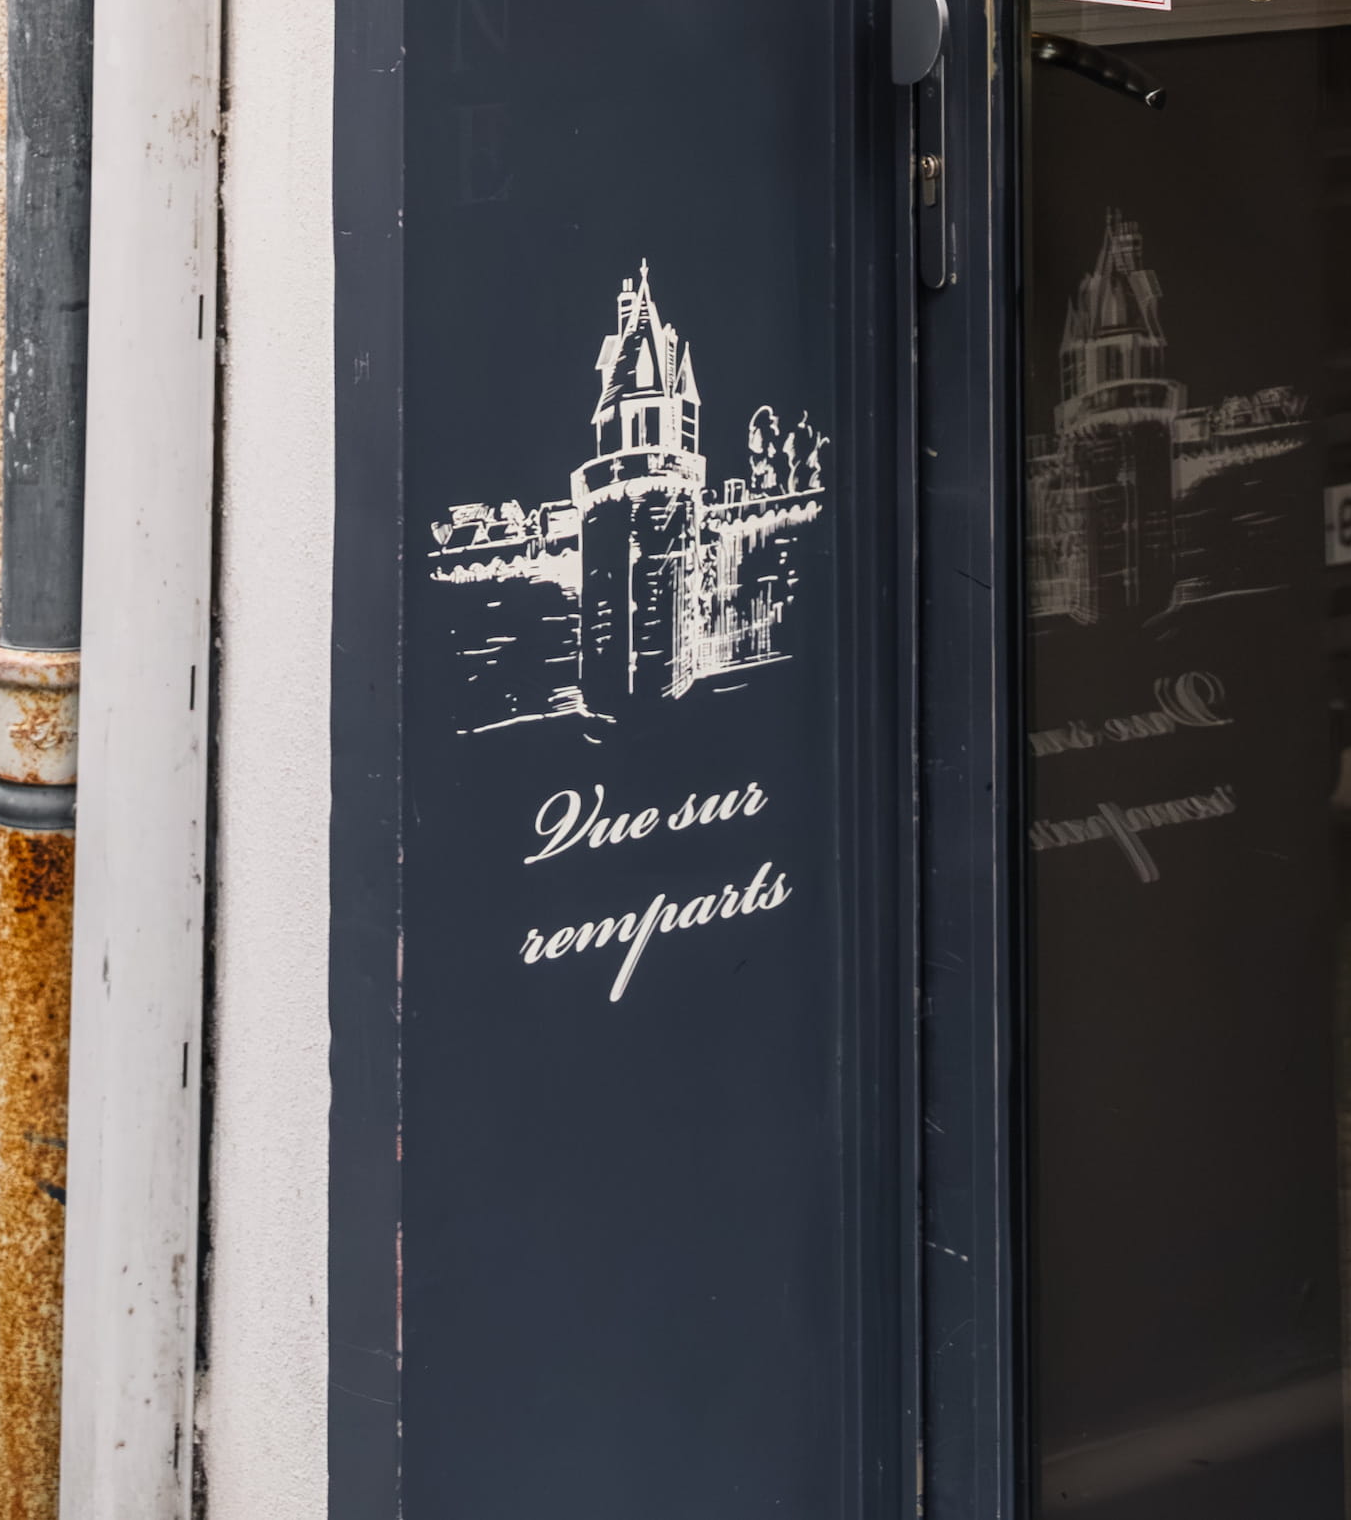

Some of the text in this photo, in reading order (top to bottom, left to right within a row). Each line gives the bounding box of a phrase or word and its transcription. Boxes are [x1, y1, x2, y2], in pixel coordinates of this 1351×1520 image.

[523, 779, 769, 865] Vue sur
[519, 860, 793, 1003] remparts
